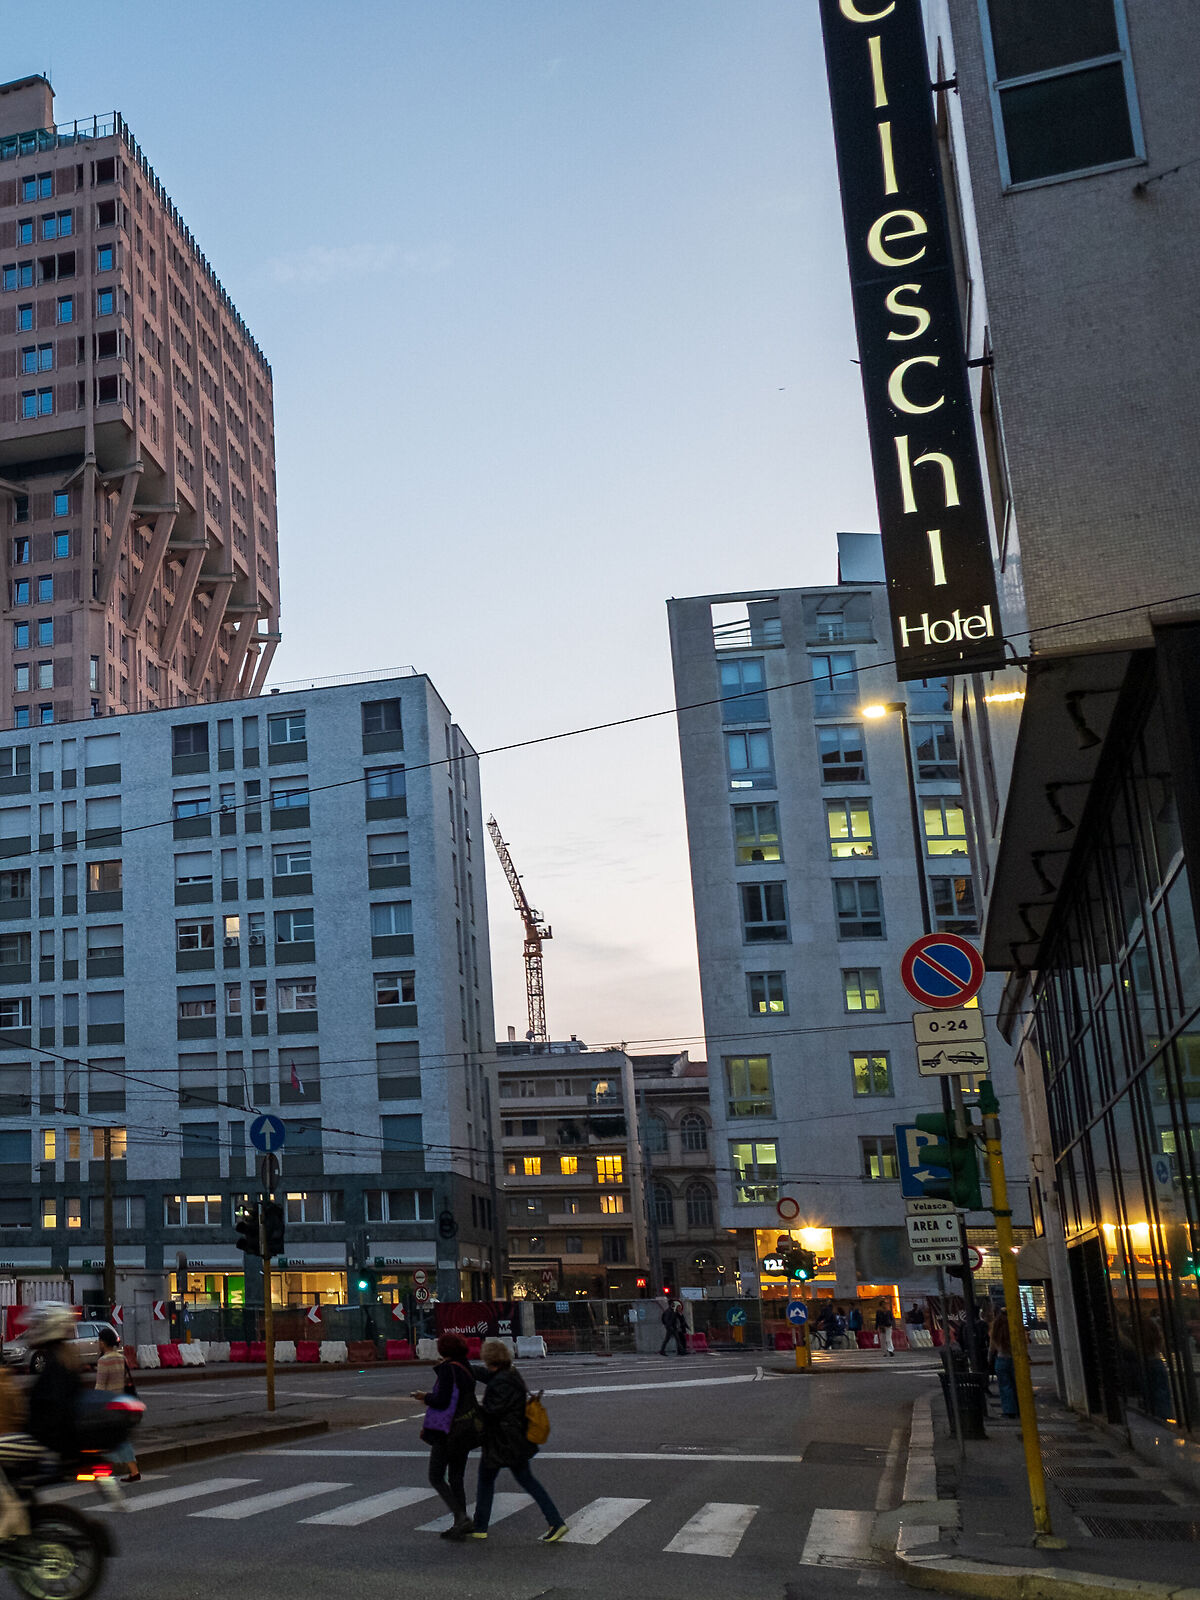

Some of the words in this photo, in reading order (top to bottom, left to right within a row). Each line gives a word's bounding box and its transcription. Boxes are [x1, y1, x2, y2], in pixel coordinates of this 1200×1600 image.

[898, 604, 994, 648] Hotel
[929, 1020, 968, 1032] 0-24
[905, 1128, 938, 1167] P
[913, 1220, 940, 1231] AREA
[946, 1220, 953, 1230] C
[917, 1254, 931, 1262] CAR
[935, 1252, 957, 1261] WASH
[417, 1290, 426, 1299] 30
[443, 1325, 476, 1334] webuild
